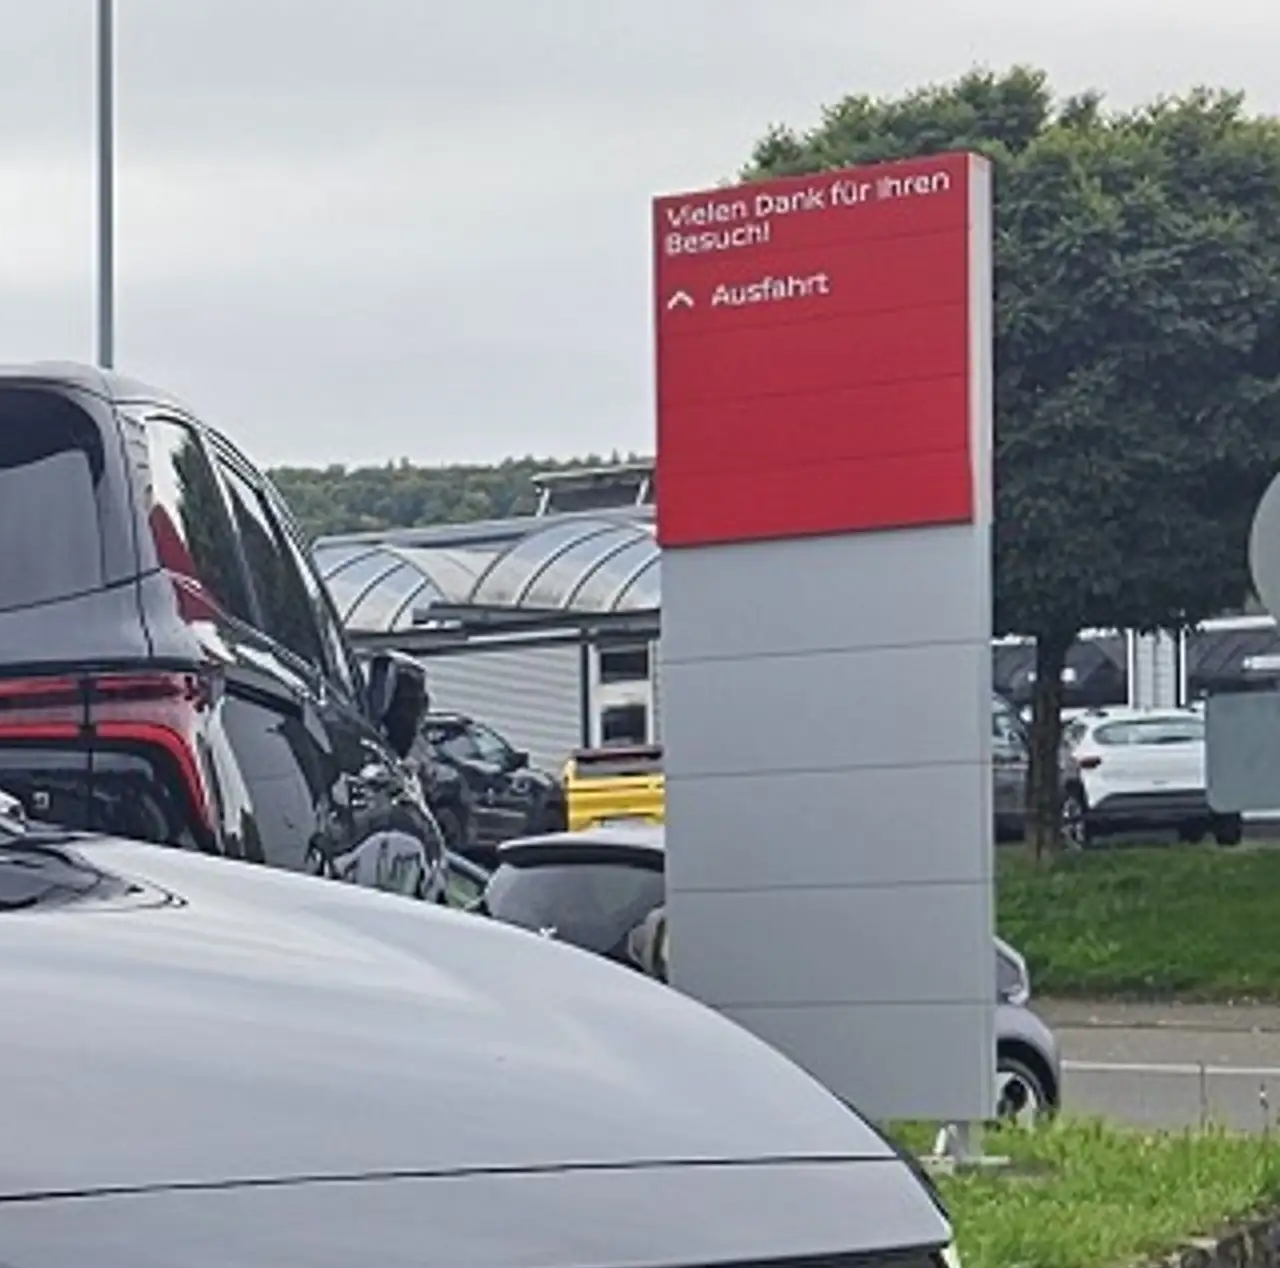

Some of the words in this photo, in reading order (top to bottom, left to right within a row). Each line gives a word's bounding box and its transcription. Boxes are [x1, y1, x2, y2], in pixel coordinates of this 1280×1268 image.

[666, 201, 747, 227] Vielen
[755, 187, 825, 217] Dank
[831, 179, 871, 206] für
[876, 171, 949, 198] Ihren
[666, 220, 770, 255] Besuch!
[711, 272, 829, 306] Ausfahrt
